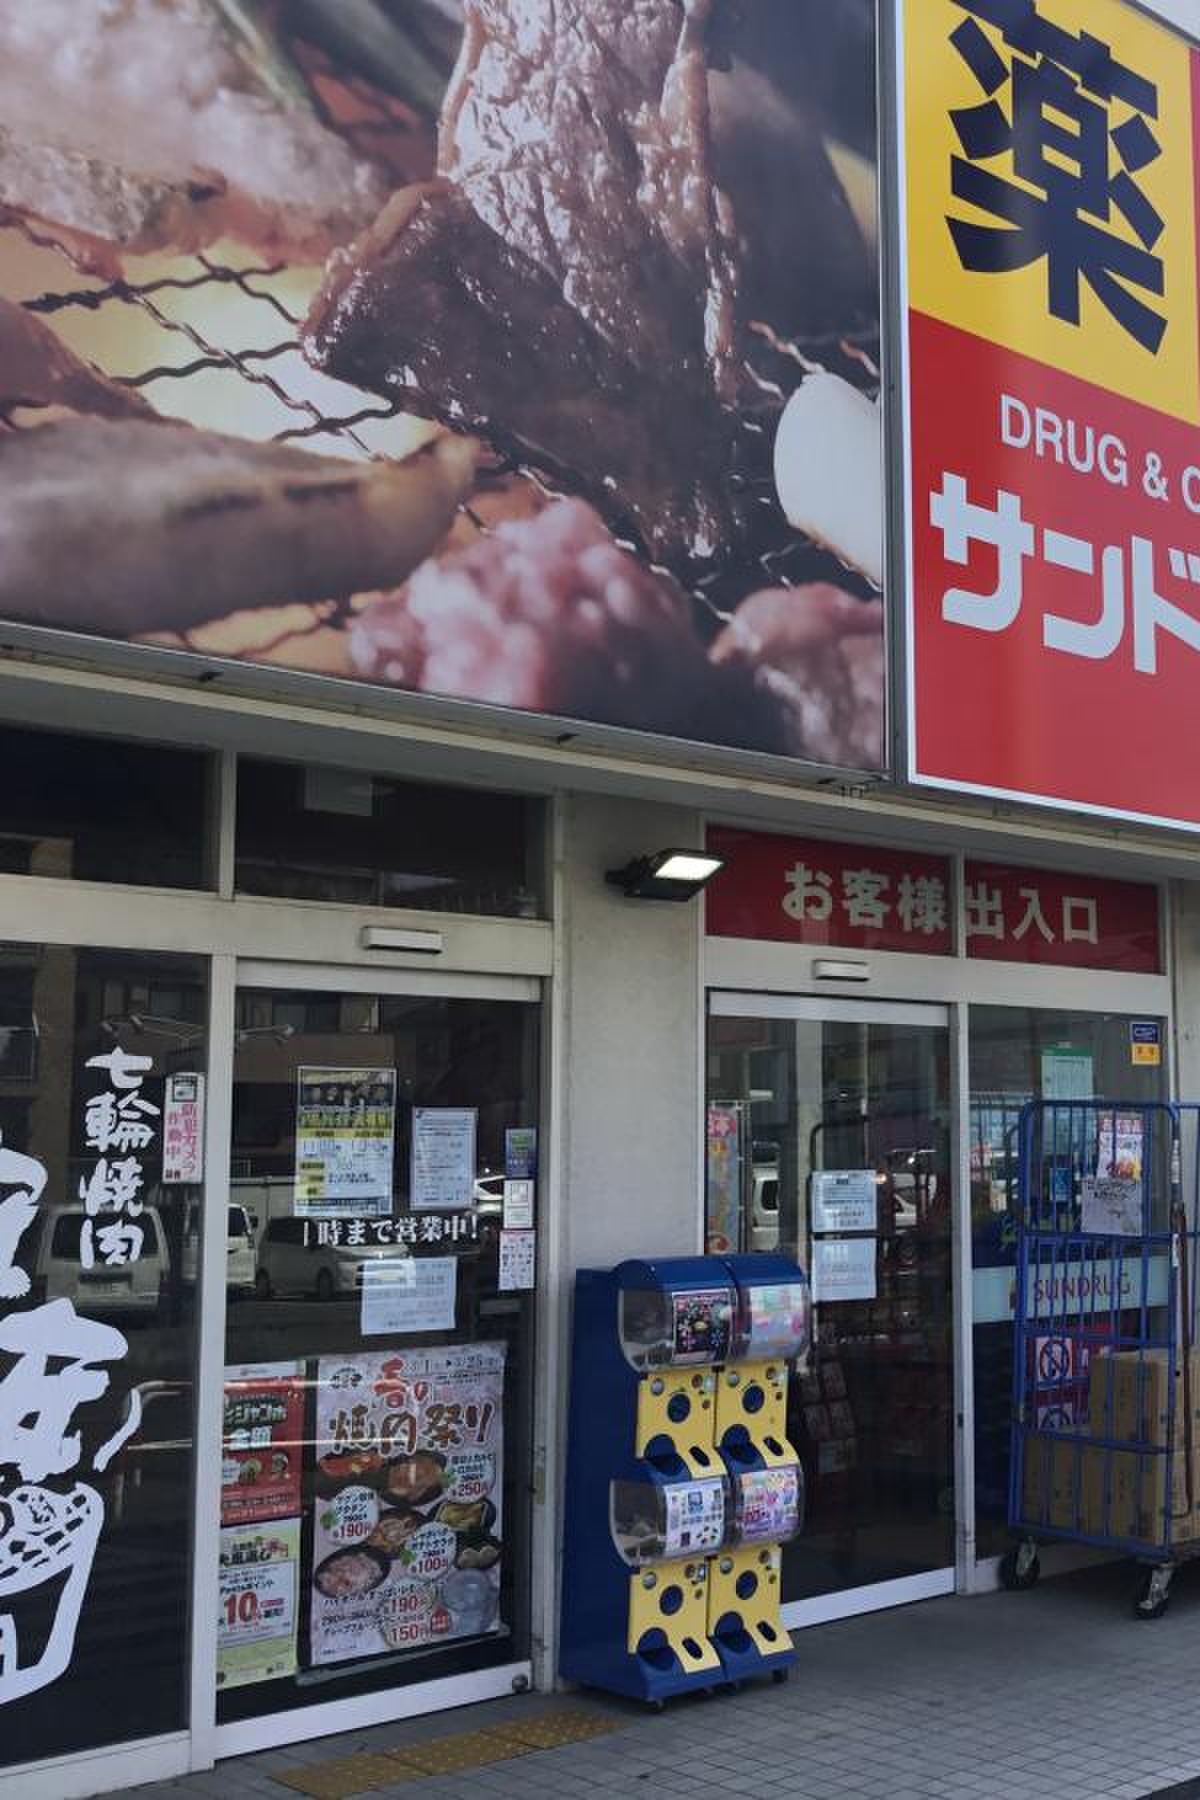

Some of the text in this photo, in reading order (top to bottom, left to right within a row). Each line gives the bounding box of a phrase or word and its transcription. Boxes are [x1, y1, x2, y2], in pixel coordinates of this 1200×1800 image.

[944, 0, 1168, 356] 薬
[1000, 394, 1128, 488] DRUG
[1143, 452, 1169, 501] &
[781, 861, 1099, 945] お客様出入口
[79, 1046, 161, 1270] 七輪焼肉
[1034, 1273, 1131, 1301] SUNDRUG
